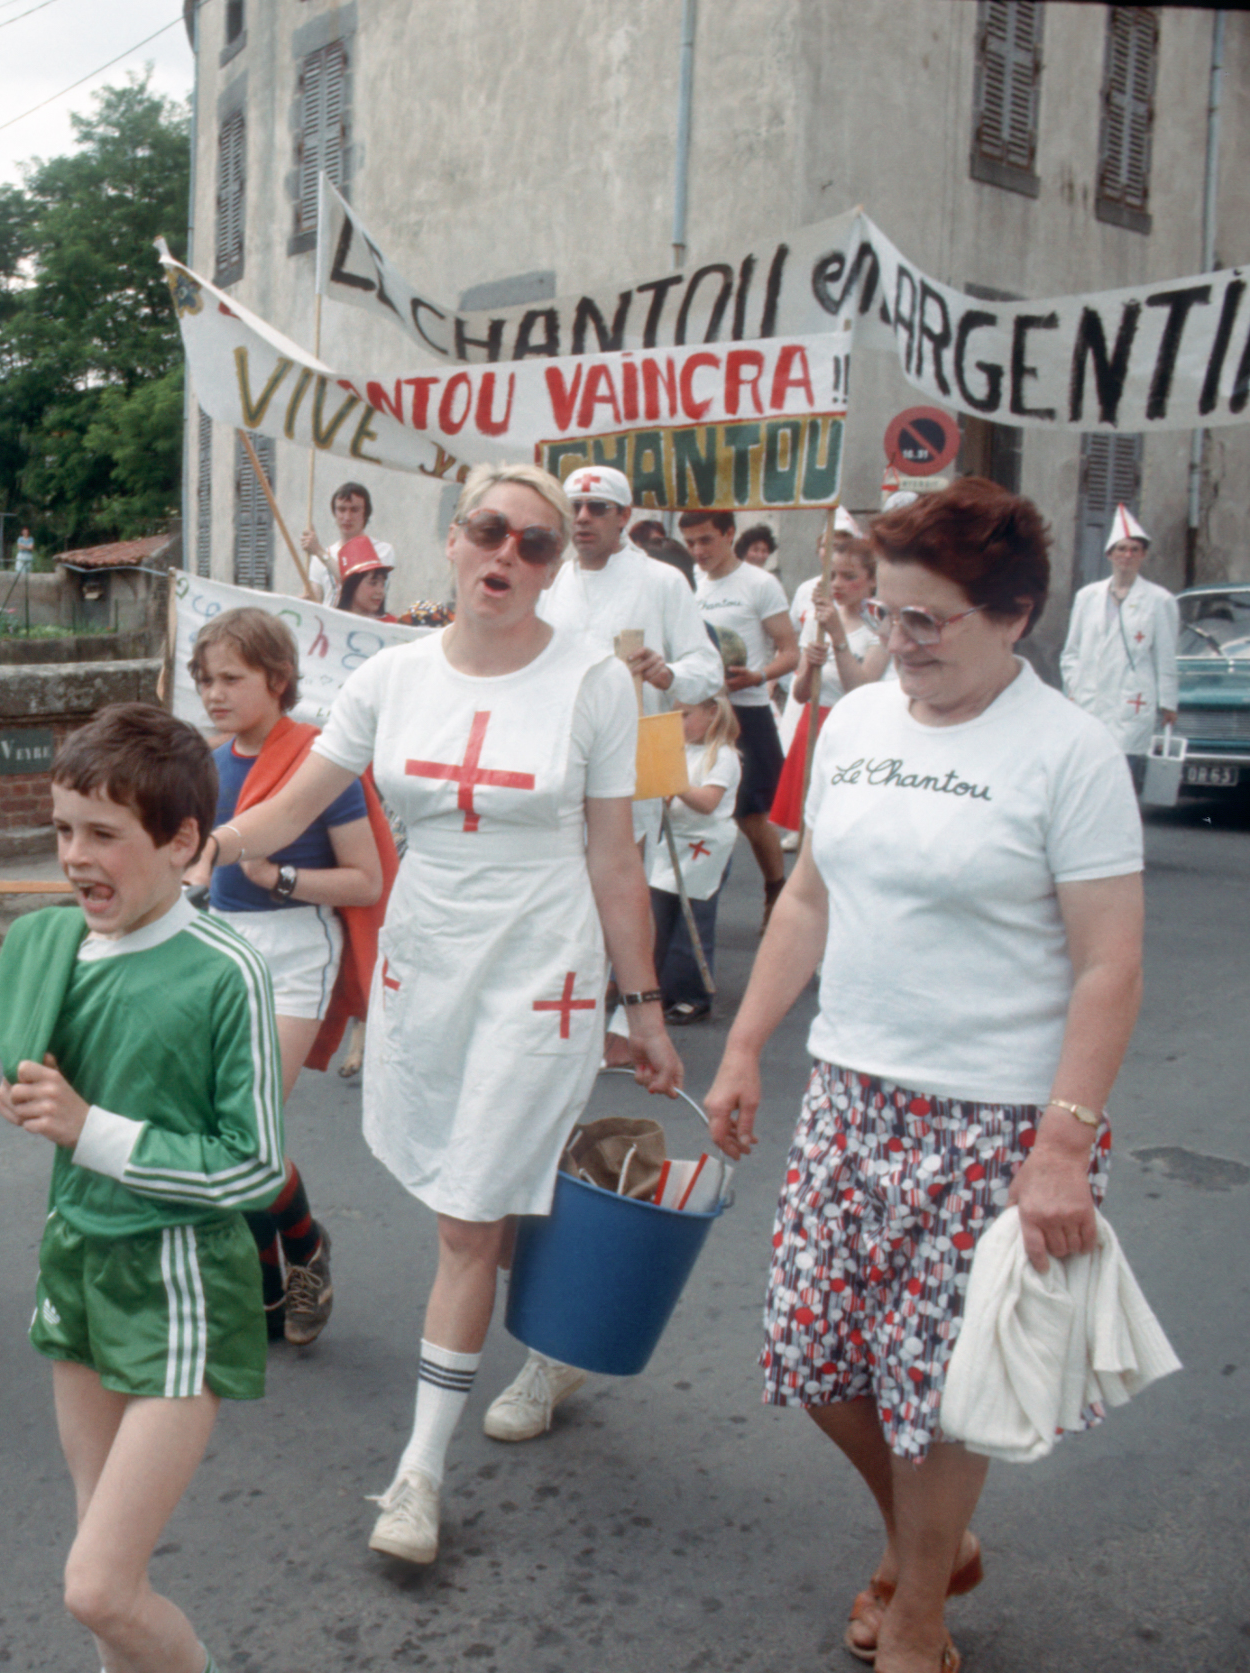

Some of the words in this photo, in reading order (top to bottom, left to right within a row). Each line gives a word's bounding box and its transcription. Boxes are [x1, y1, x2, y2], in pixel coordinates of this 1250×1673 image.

[410, 243, 789, 363] CHANTOU
[880, 264, 1250, 428] ARGENTI
[233, 346, 382, 464] VIVE
[831, 758, 865, 785] Le
[866, 757, 992, 801] Chantou
